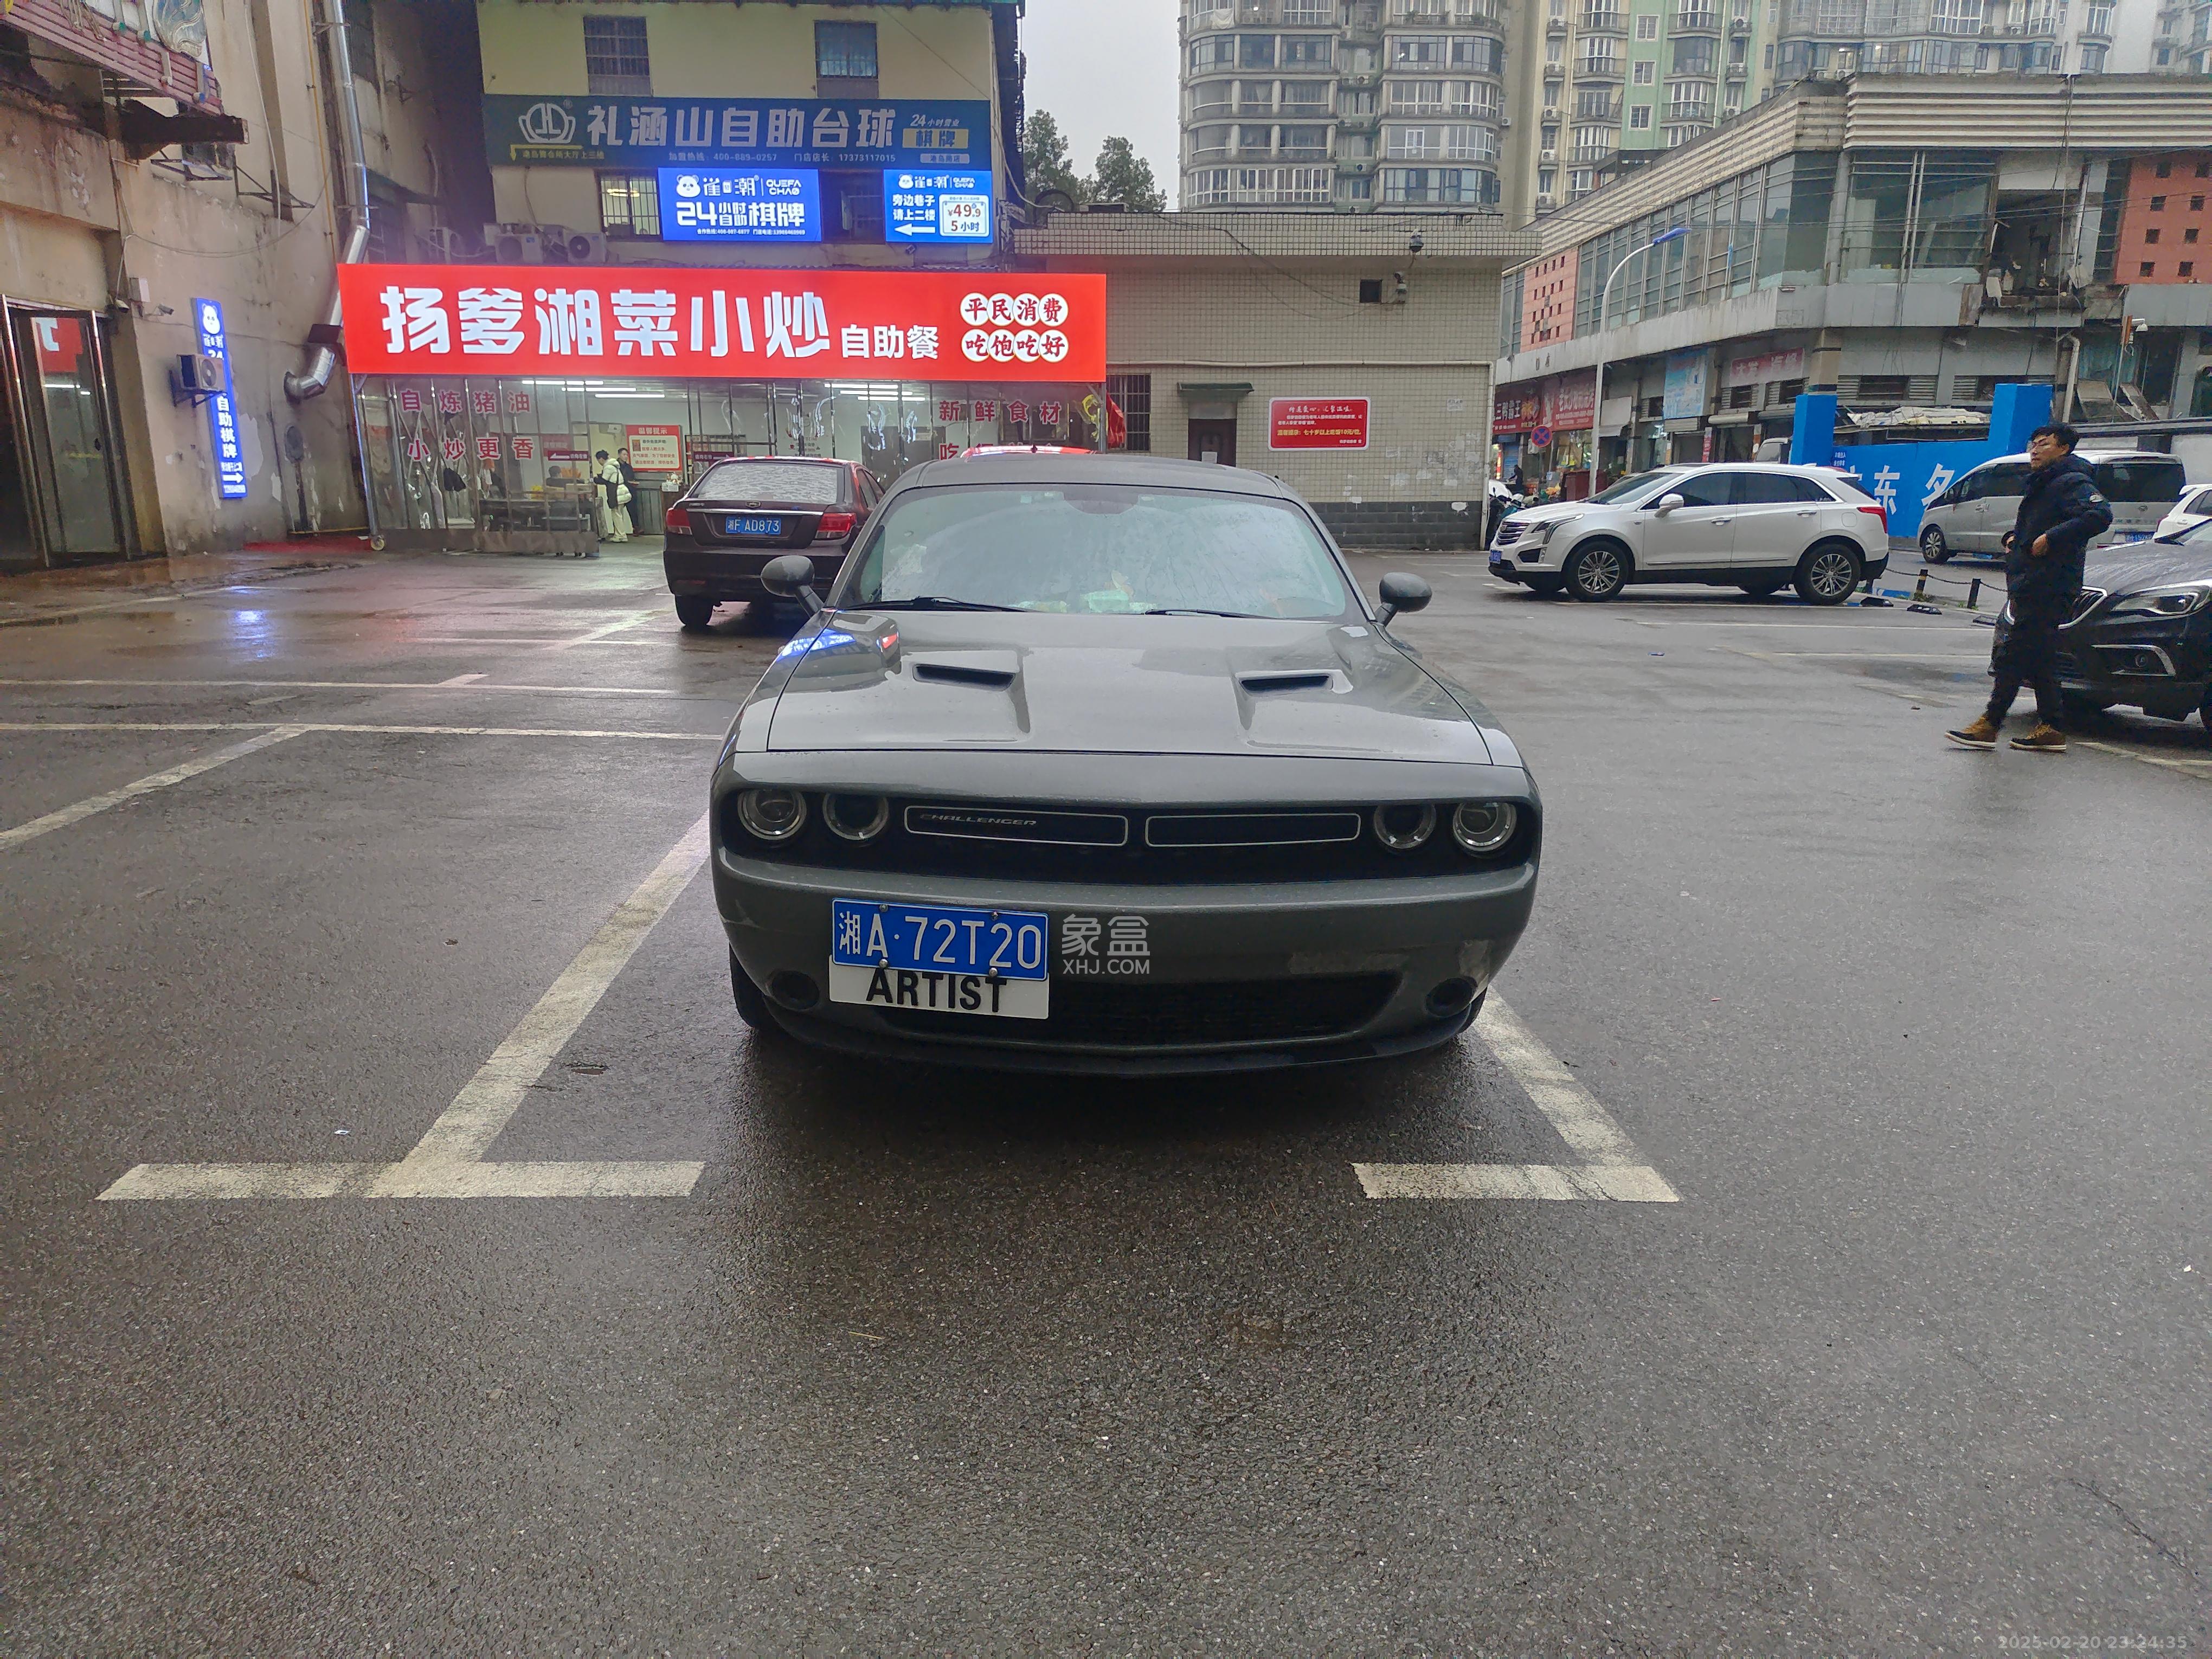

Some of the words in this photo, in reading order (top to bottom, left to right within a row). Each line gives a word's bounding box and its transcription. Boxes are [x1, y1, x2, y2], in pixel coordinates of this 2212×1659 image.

[588, 105, 896, 148] 礼涵山自助台球
[916, 130, 955, 147] 棋牌
[766, 179, 801, 188] QUEFA
[892, 194, 935, 207] 旁边巷子
[893, 209, 936, 221] 请上二楼
[380, 286, 829, 358] 扬爹湘菜小炒
[841, 324, 939, 359] 自助餐
[964, 298, 1063, 322] 平民消费
[965, 333, 1065, 358] 吃饱吃好
[400, 388, 531, 415] 自炼猪油
[939, 400, 1062, 425] 新鲜食材
[217, 395, 237, 459] 自助棋牌
[407, 436, 535, 462] 小炒更香
[920, 814, 1037, 826] CHALLENGER
[838, 911, 1041, 970] 湘A·72T20
[866, 968, 1007, 1013] ARTIST
